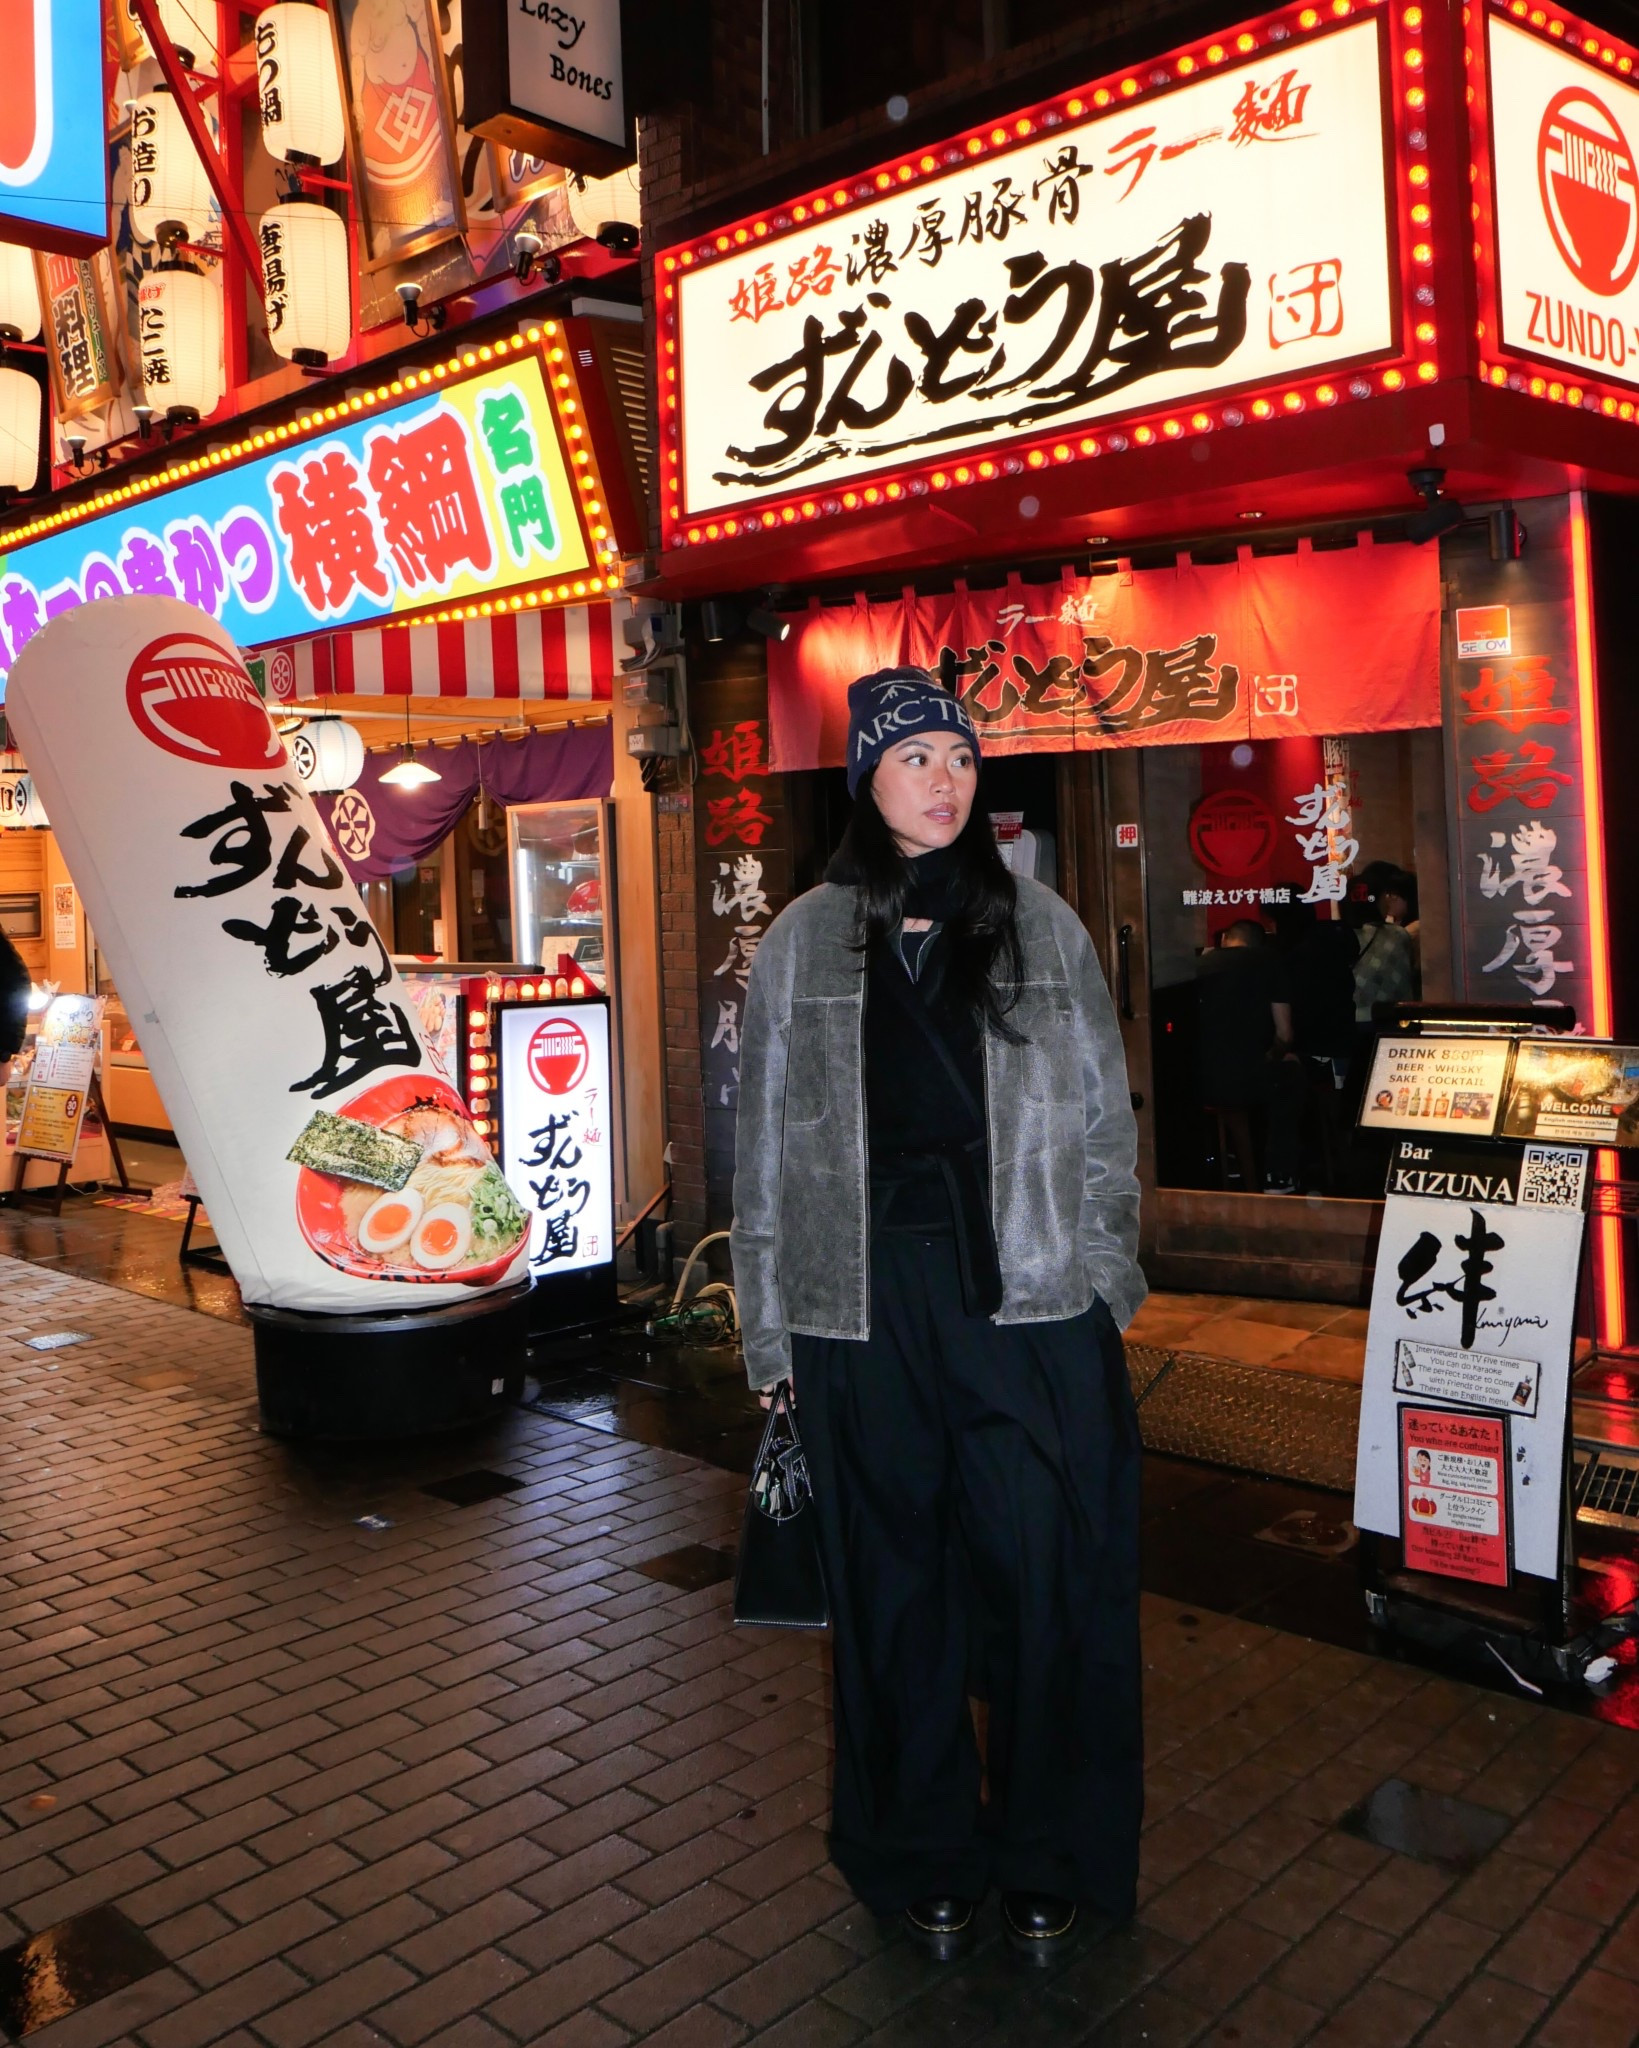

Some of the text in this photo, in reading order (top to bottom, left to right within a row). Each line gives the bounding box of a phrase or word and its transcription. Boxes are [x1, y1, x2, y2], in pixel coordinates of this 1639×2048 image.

[520, 0, 586, 50] Lazy
[257, 22, 283, 127] もつ鍋
[549, 53, 613, 100] Bones
[133, 106, 157, 207] お造り
[261, 223, 288, 332] 唐揚げ
[1526, 290, 1639, 368] ZUNDO-
[140, 307, 171, 386] たこ焼
[712, 210, 1251, 488] ずんどう屋
[482, 392, 555, 558] 名門
[273, 412, 492, 611] 横綱
[996, 595, 1100, 637] ラー麺
[1461, 640, 1506, 653] SECOM
[1254, 674, 1299, 718] 団
[1119, 826, 1136, 845] 押
[1285, 782, 1359, 903] ずんどう屋
[1460, 655, 1574, 1008] 姫路濃厚
[1182, 888, 1290, 906] 難波えびす橋店
[1388, 1048, 1437, 1060] DRINK
[1396, 1063, 1484, 1074] BEER WHISKY
[1389, 1074, 1486, 1087] SAKE COCKTAIL
[582, 1088, 602, 1146] ラー麺
[1540, 1101, 1612, 1115] WELCOME
[1400, 1142, 1432, 1160] Bar
[519, 1110, 591, 1266] ずんどう屋
[1393, 1169, 1514, 1202] KIZUNA
[1396, 1207, 1505, 1350] 絆
[1415, 1344, 1457, 1359] Interviewed
[1470, 1354, 1482, 1363] TV
[1483, 1356, 1498, 1365] five
[1499, 1359, 1520, 1369] times
[1430, 1356, 1445, 1366] You
[1446, 1359, 1460, 1368] can
[1461, 1361, 1471, 1370] do
[1418, 1364, 1431, 1373] The
[1433, 1367, 1461, 1379] perfect
[1462, 1372, 1482, 1383] place
[1494, 1377, 1515, 1388] come
[1429, 1376, 1445, 1385] with
[1447, 1379, 1473, 1390] friends
[1485, 1385, 1500, 1395] solo
[1419, 1383, 1441, 1394] There
[1460, 1390, 1487, 1403] English
[1488, 1397, 1509, 1407] menu
[1408, 1418, 1499, 1441] 迷っているあなた！
[1410, 1433, 1499, 1454] You who are confused
[1440, 1492, 1493, 1508] グーグル口コミにて
[1447, 1502, 1487, 1515] 上位ランクイン
